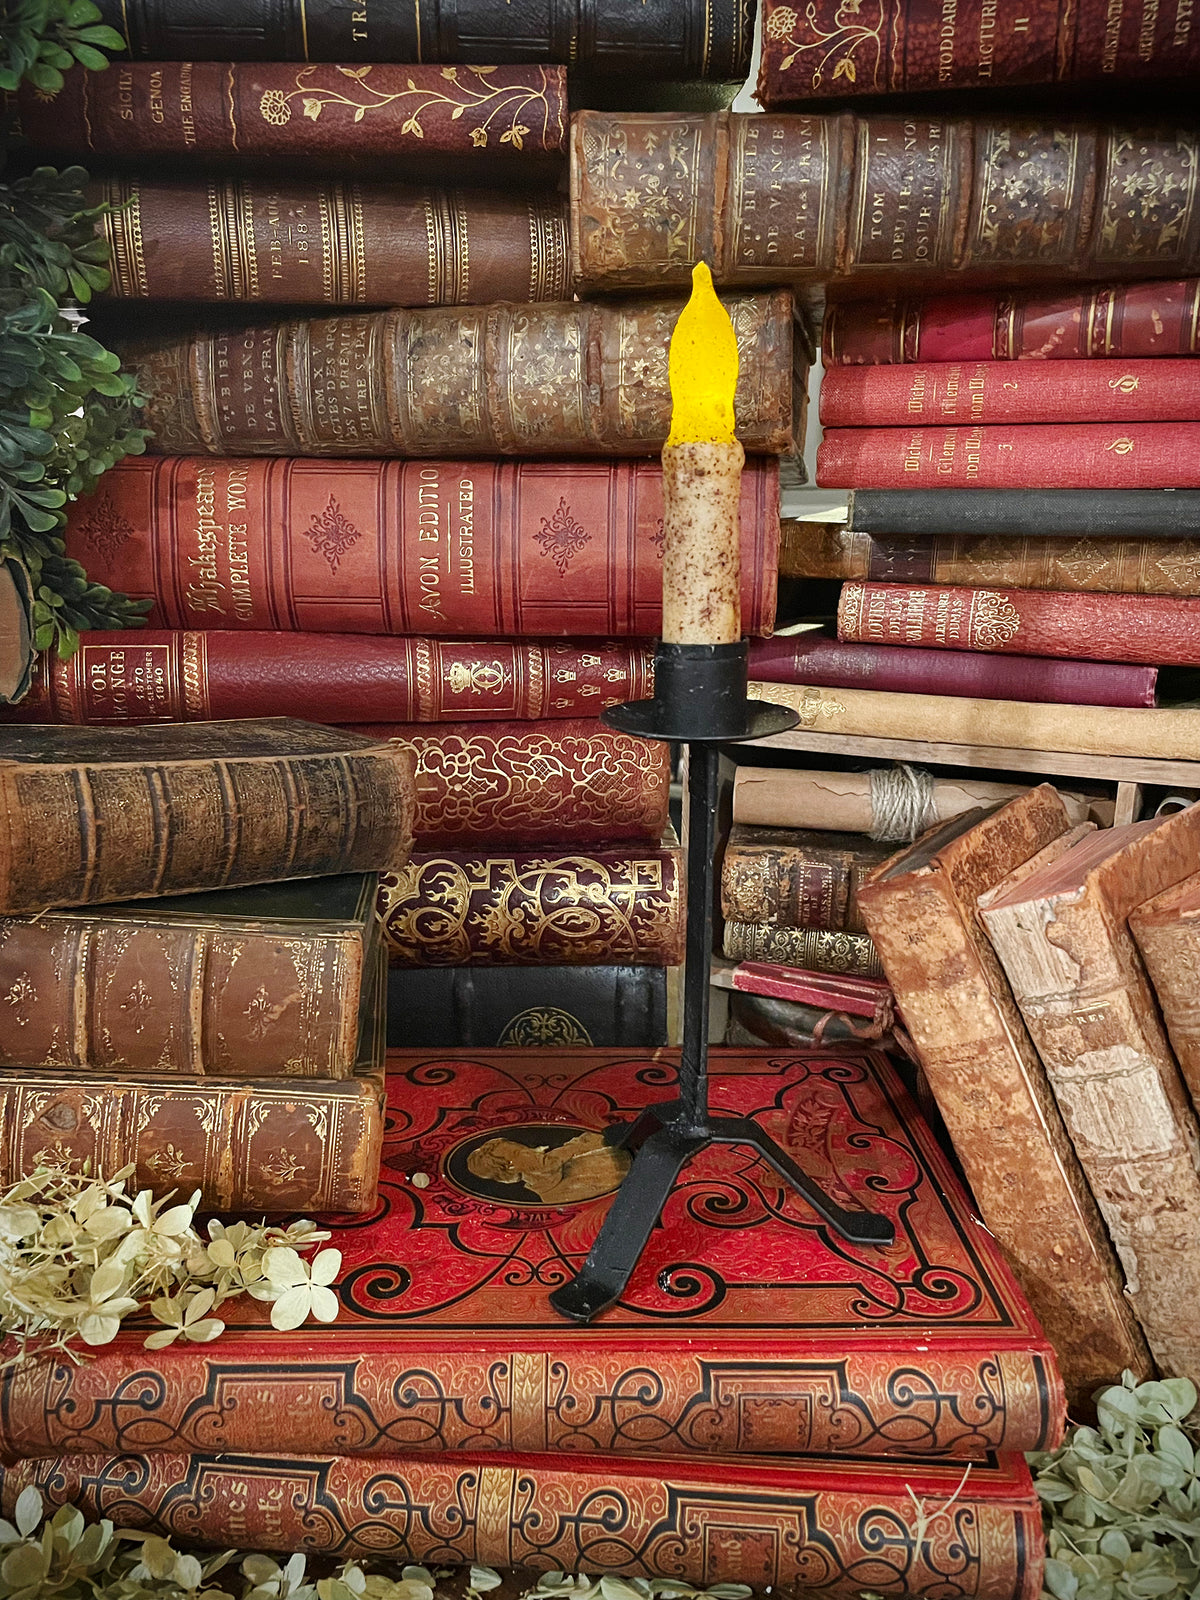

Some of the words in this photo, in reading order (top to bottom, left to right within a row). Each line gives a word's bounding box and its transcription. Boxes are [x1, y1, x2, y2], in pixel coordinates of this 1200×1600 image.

[118, 69, 134, 120] SICILY
[150, 71, 164, 123] GENOA
[181, 115, 196, 144] THE
[744, 127, 759, 210] BIBLE
[871, 192, 886, 239] TOM
[767, 225, 779, 254] DE
[326, 356, 336, 390] DES
[246, 403, 257, 427] DE
[314, 389, 329, 427] TOM
[459, 478, 474, 595] ILLUSTRATED
[228, 523, 253, 621] COMPLETE
[868, 591, 887, 638] LOUISE
[889, 617, 901, 634] DE
[891, 598, 904, 613] LA
[935, 593, 950, 643] ALEXANDRE
[949, 600, 963, 638] DUMAS
[91, 662, 107, 705] VOR
